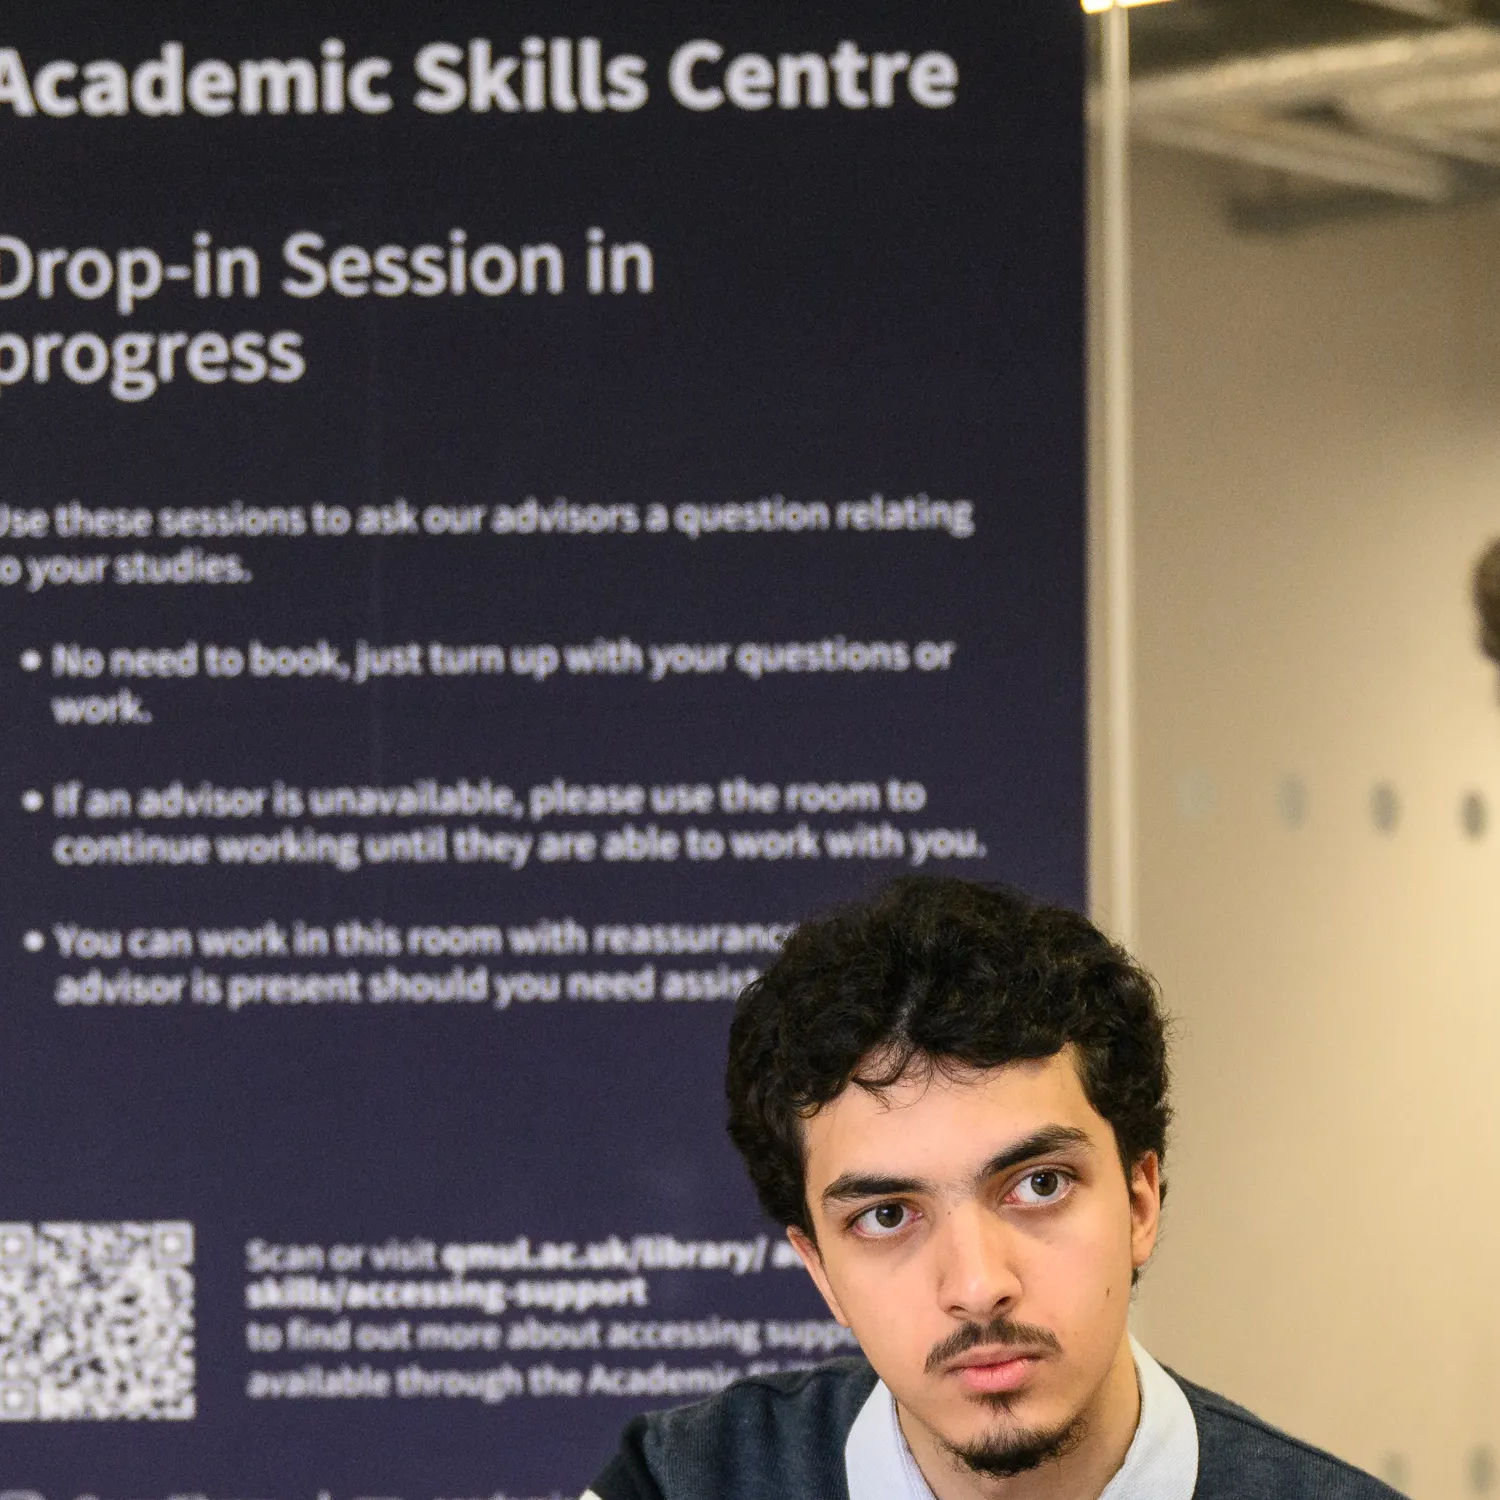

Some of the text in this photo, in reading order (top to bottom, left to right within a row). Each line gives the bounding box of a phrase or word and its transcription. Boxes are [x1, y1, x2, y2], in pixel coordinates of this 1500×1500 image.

[413, 35, 649, 114] Skills
[668, 38, 959, 112] Centre
[281, 227, 565, 299] Session
[586, 226, 654, 295] in
[52, 500, 155, 539] these
[157, 501, 309, 538] sessions
[309, 502, 353, 537] to
[355, 498, 419, 536] ask
[421, 504, 488, 536] our
[490, 497, 642, 535] advisors
[643, 502, 671, 534] a
[672, 497, 832, 539] question
[834, 493, 976, 539] relating
[25, 554, 110, 593] your
[112, 547, 253, 586] studies.
[50, 636, 957, 685] No need to book, just turn up with your questions or
[50, 688, 153, 726] work.
[52, 776, 928, 822] If an advisor is unavailable, please use the room to
[51, 822, 988, 873] continue working until they are able to work with you.
[52, 918, 798, 960] You can work in this room with reassuranc
[53, 968, 188, 1007] advisor
[189, 969, 225, 1006] is
[225, 969, 363, 1011] present
[366, 965, 490, 1004] should
[492, 971, 562, 1010] you
[565, 964, 657, 1002] need
[245, 1239, 326, 1273] Scan
[327, 1244, 366, 1272] or
[369, 1241, 438, 1271] visit
[244, 1321, 285, 1353] to
[284, 1316, 353, 1352] find
[353, 1320, 413, 1352] out
[414, 1323, 504, 1351] more
[504, 1316, 603, 1351] about
[605, 1316, 763, 1356] accessing
[245, 1365, 393, 1399] available
[393, 1363, 526, 1405] through
[526, 1363, 585, 1397] the
